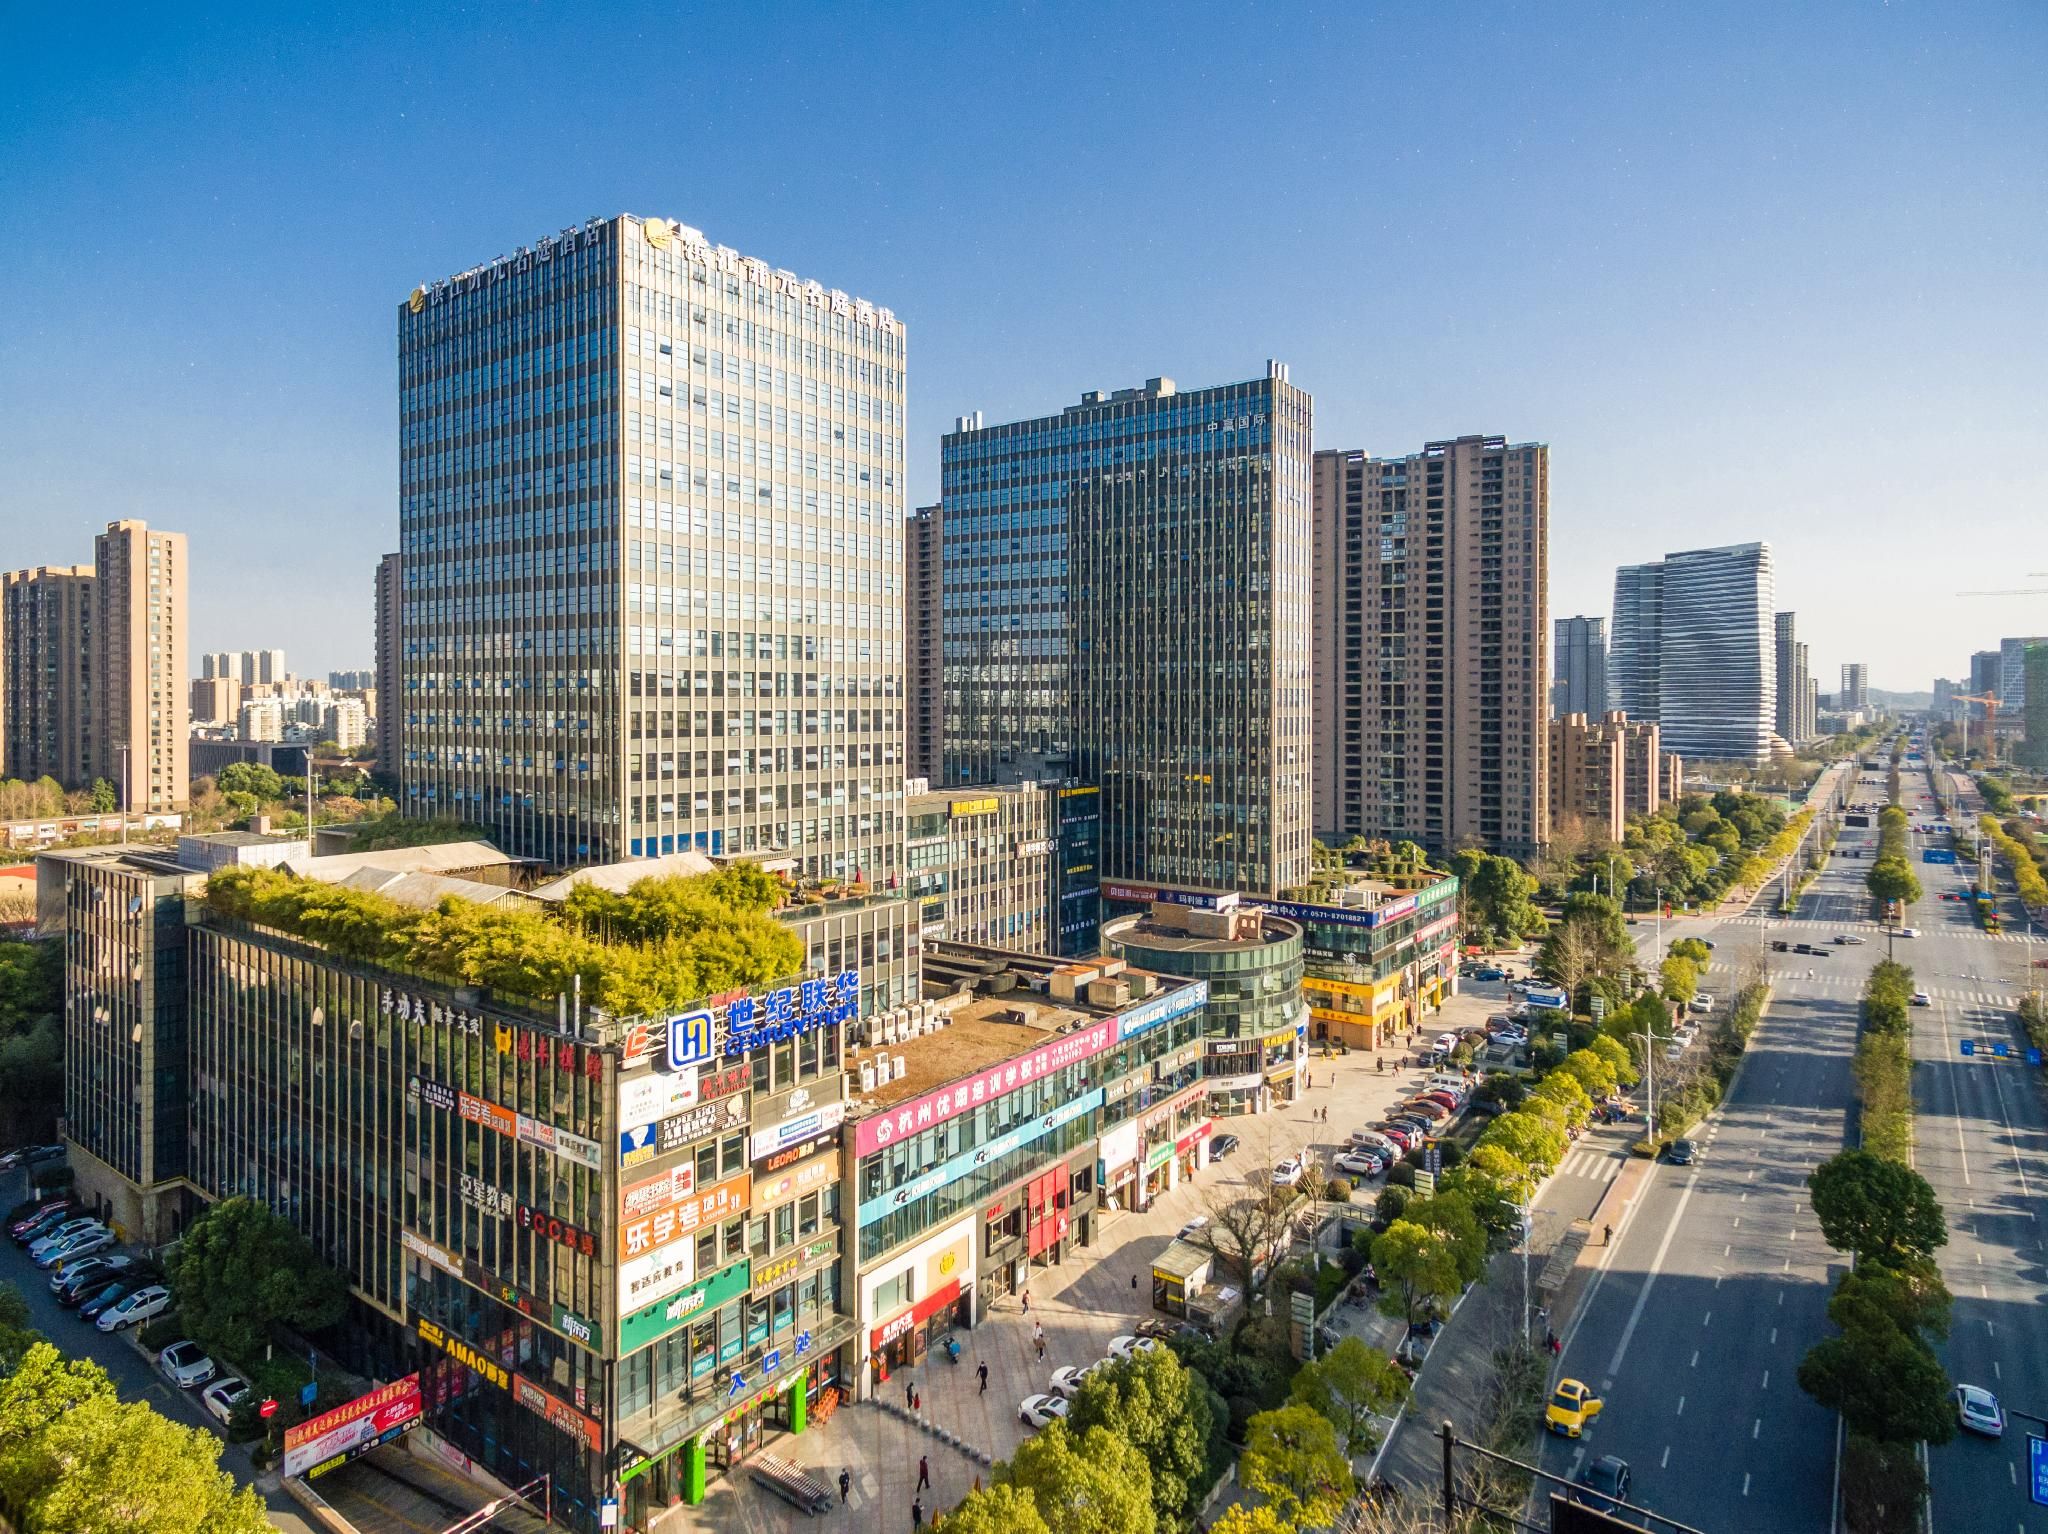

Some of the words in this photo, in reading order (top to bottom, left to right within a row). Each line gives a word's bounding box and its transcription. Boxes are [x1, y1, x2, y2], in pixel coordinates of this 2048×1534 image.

[727, 969, 859, 1035] 世纪联华
[1091, 1028, 1107, 1049] 3F
[460, 1095, 491, 1125] 乐学考
[626, 1200, 700, 1256] 乐学考
